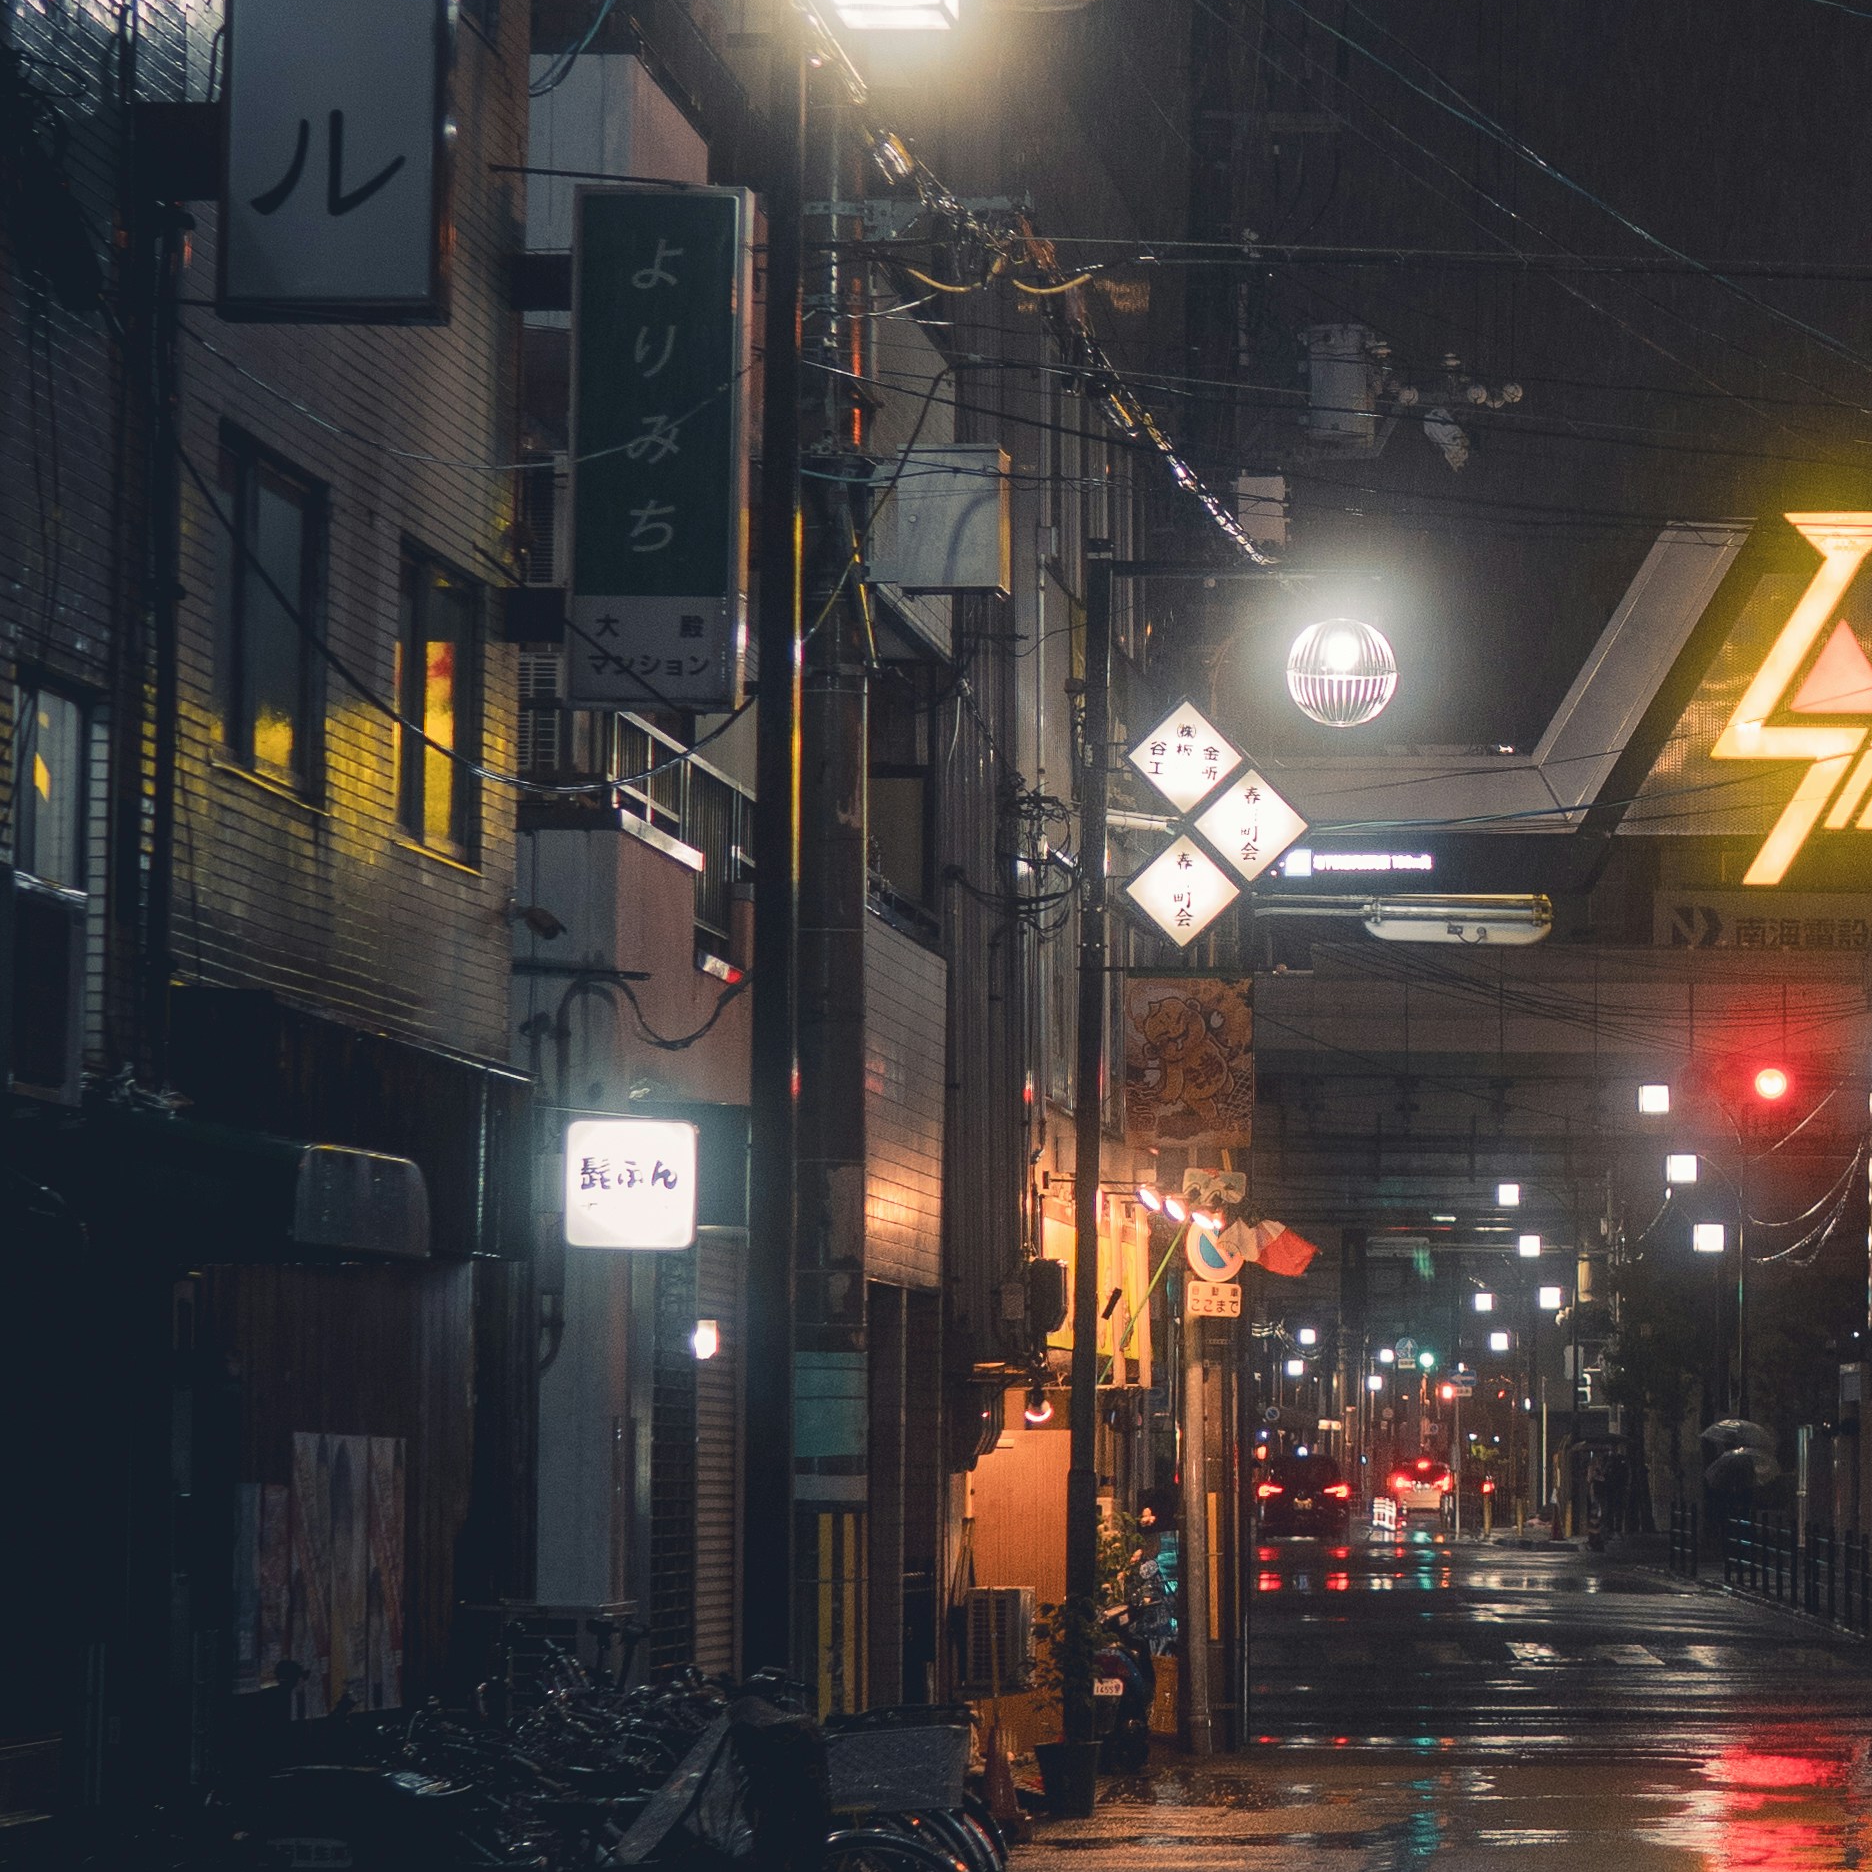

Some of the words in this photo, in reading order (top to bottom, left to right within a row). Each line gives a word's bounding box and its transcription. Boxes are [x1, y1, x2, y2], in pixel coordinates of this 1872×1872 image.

[628, 238, 686, 553] よりみち
[588, 654, 710, 677] マンション
[1191, 1298, 1239, 1314] ここまで
